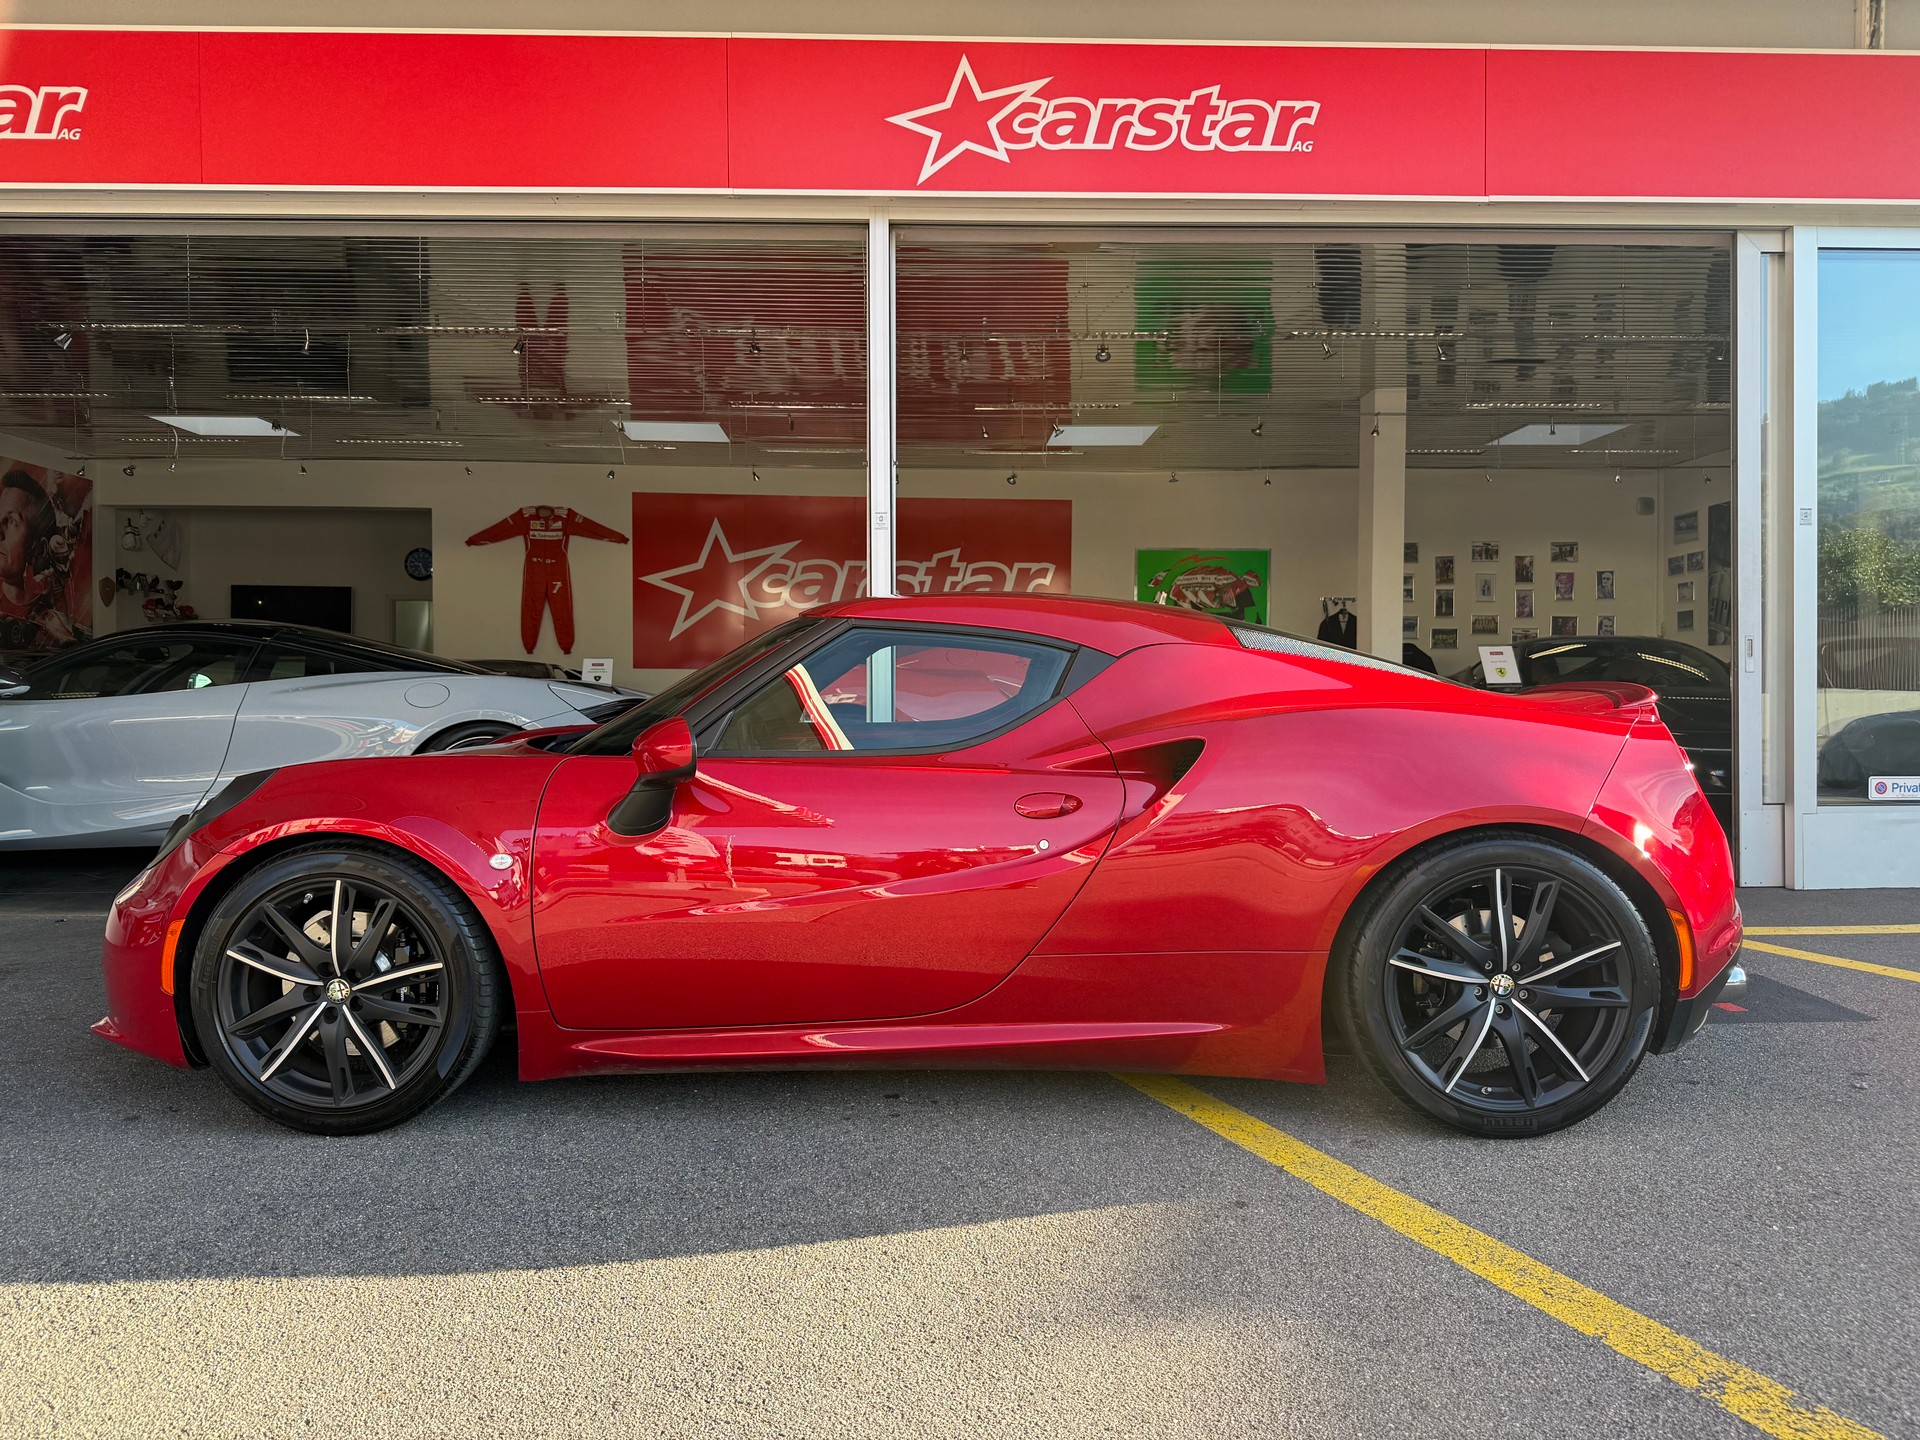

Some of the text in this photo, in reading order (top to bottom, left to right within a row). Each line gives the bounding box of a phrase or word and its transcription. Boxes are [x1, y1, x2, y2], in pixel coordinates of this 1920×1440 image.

[991, 84, 1321, 152] carstar AG
[57, 128, 81, 140] AG
[552, 581, 562, 594] 7
[1891, 782, 1920, 793] Priva
